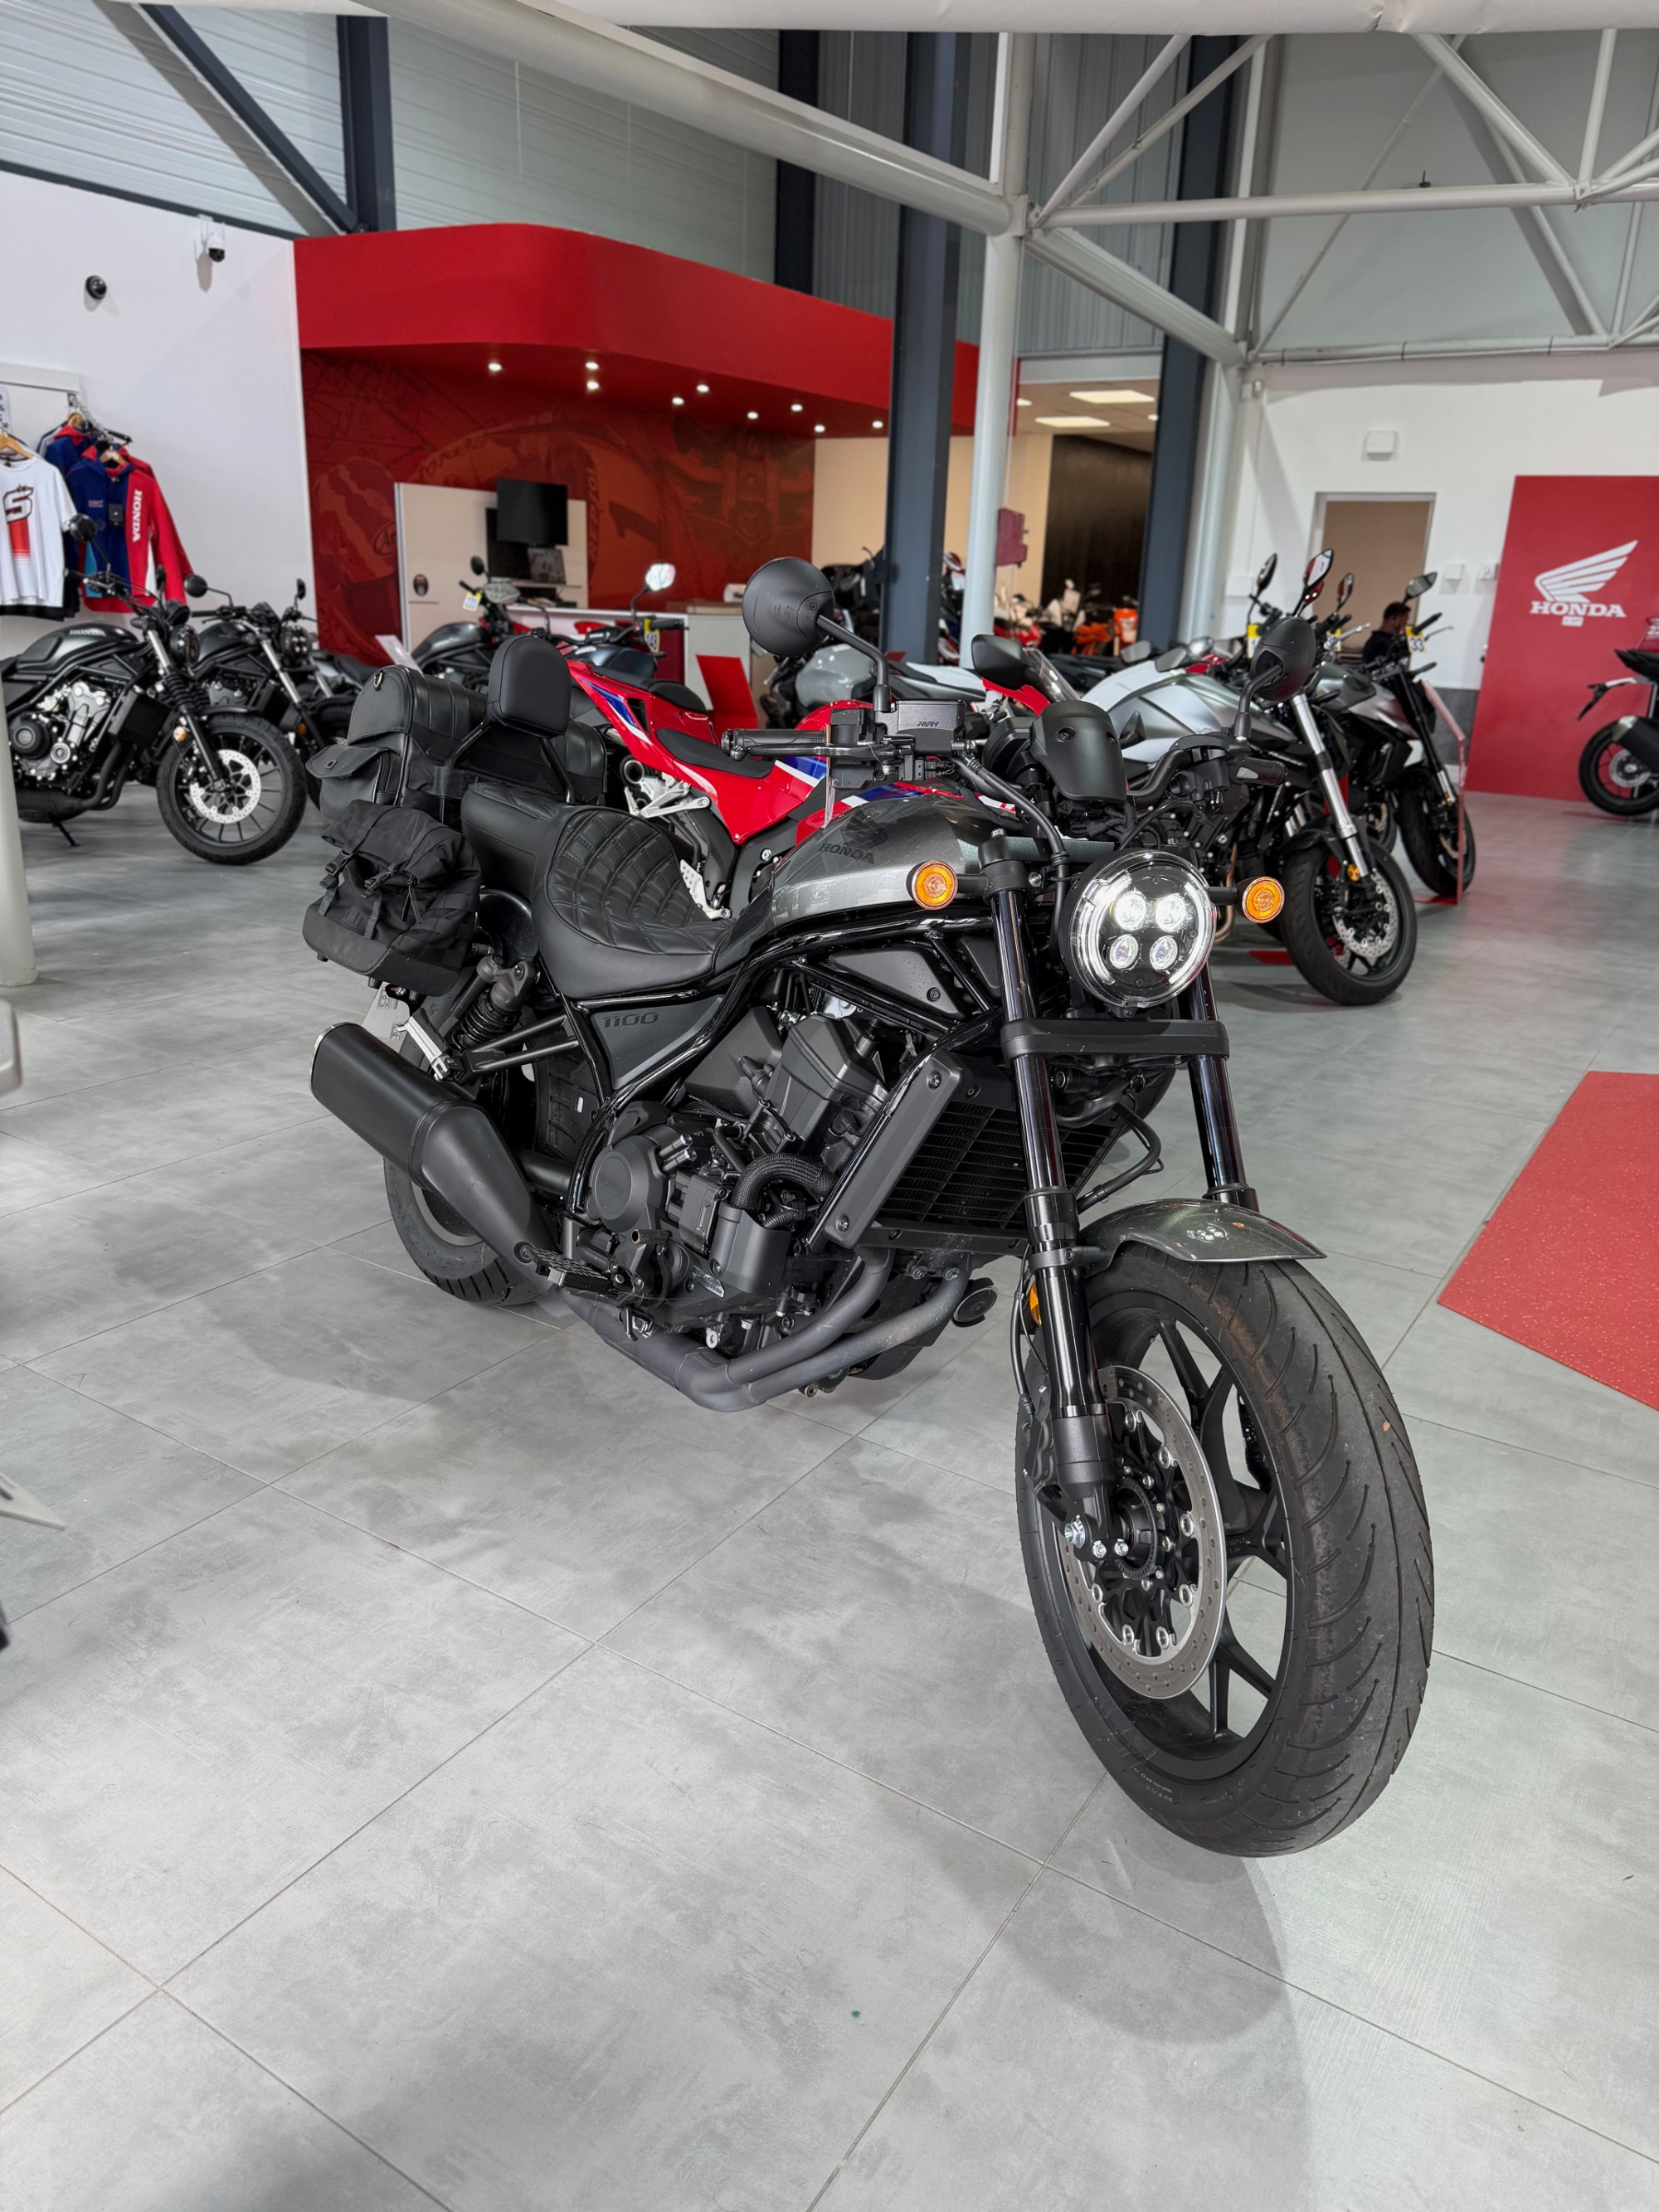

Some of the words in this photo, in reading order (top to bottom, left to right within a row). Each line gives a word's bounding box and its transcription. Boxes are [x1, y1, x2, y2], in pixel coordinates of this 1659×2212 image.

[133, 489, 143, 543] HONDA
[1530, 601, 1627, 619] HONDA
[1410, 637, 1424, 652] 33
[818, 843, 875, 864] HONDA
[603, 1012, 659, 1028] 1100
